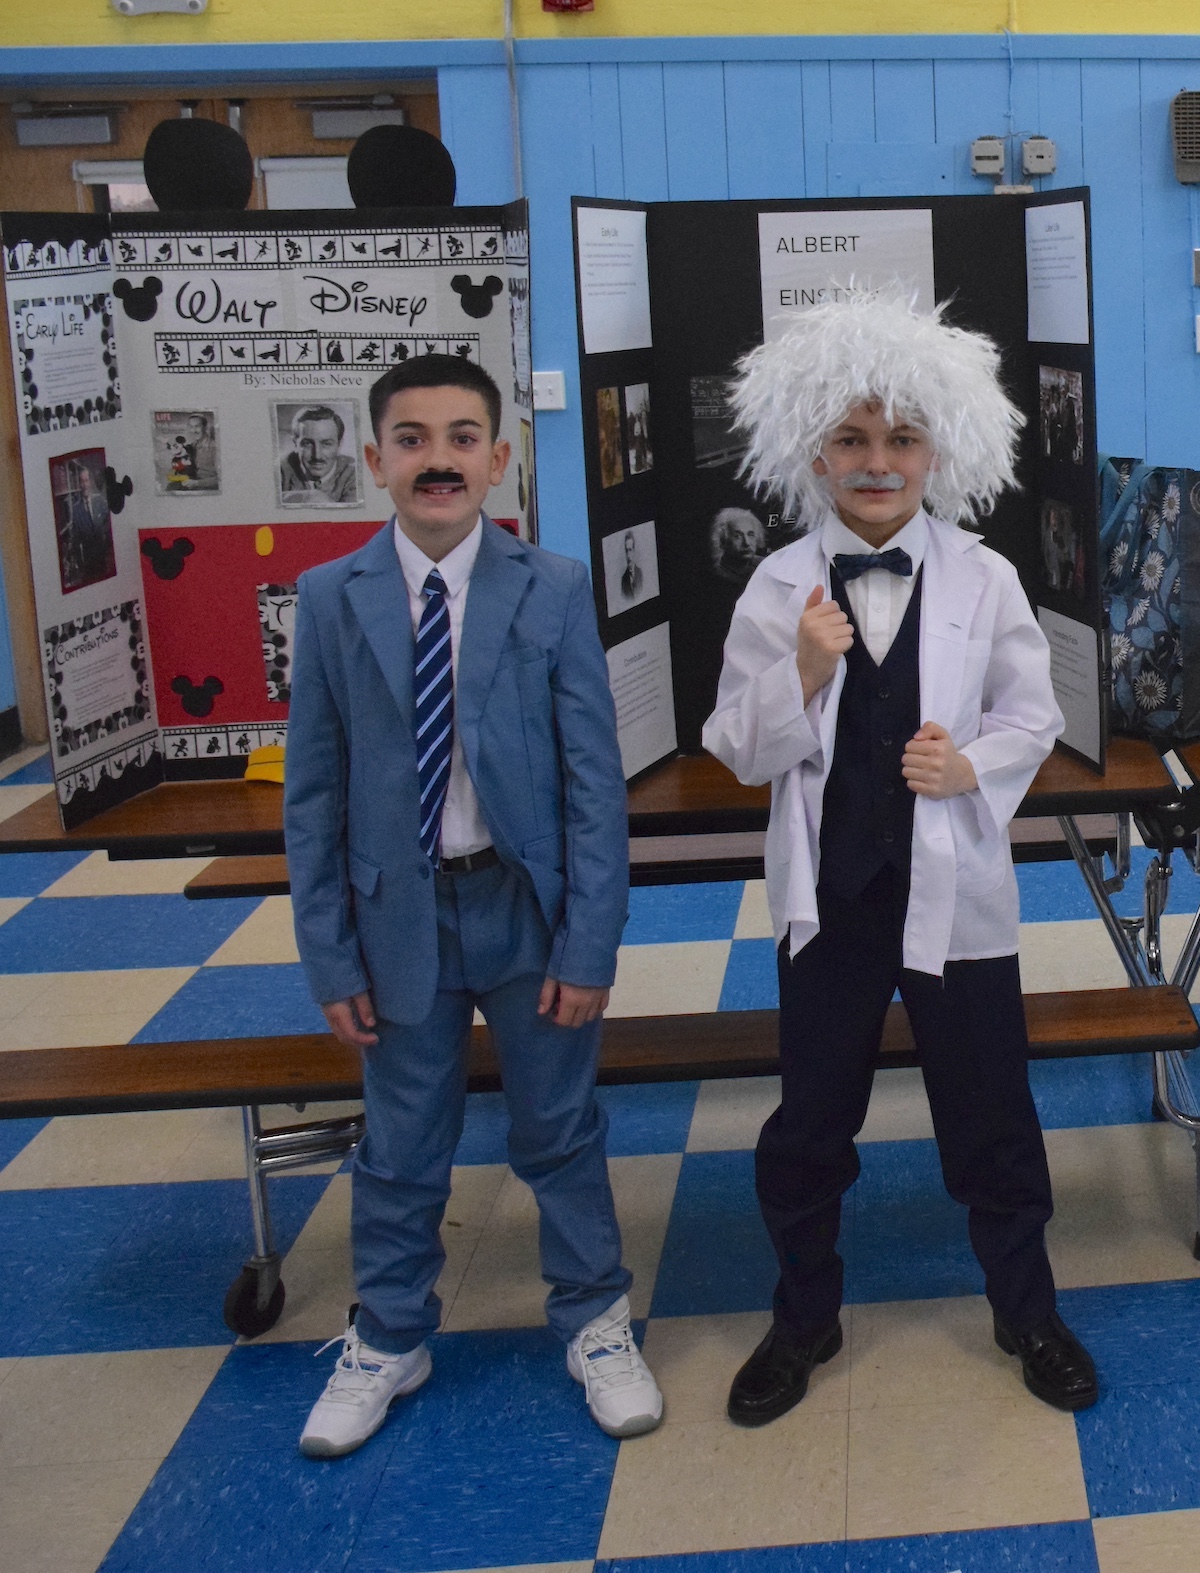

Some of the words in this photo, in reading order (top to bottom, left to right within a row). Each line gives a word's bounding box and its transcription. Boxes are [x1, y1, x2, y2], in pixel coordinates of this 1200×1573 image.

[777, 236, 860, 253] ALBERT
[244, 374, 266, 387] By:
[270, 373, 326, 386] Nicholas
[330, 375, 363, 386] Neve
[767, 514, 779, 527] E
